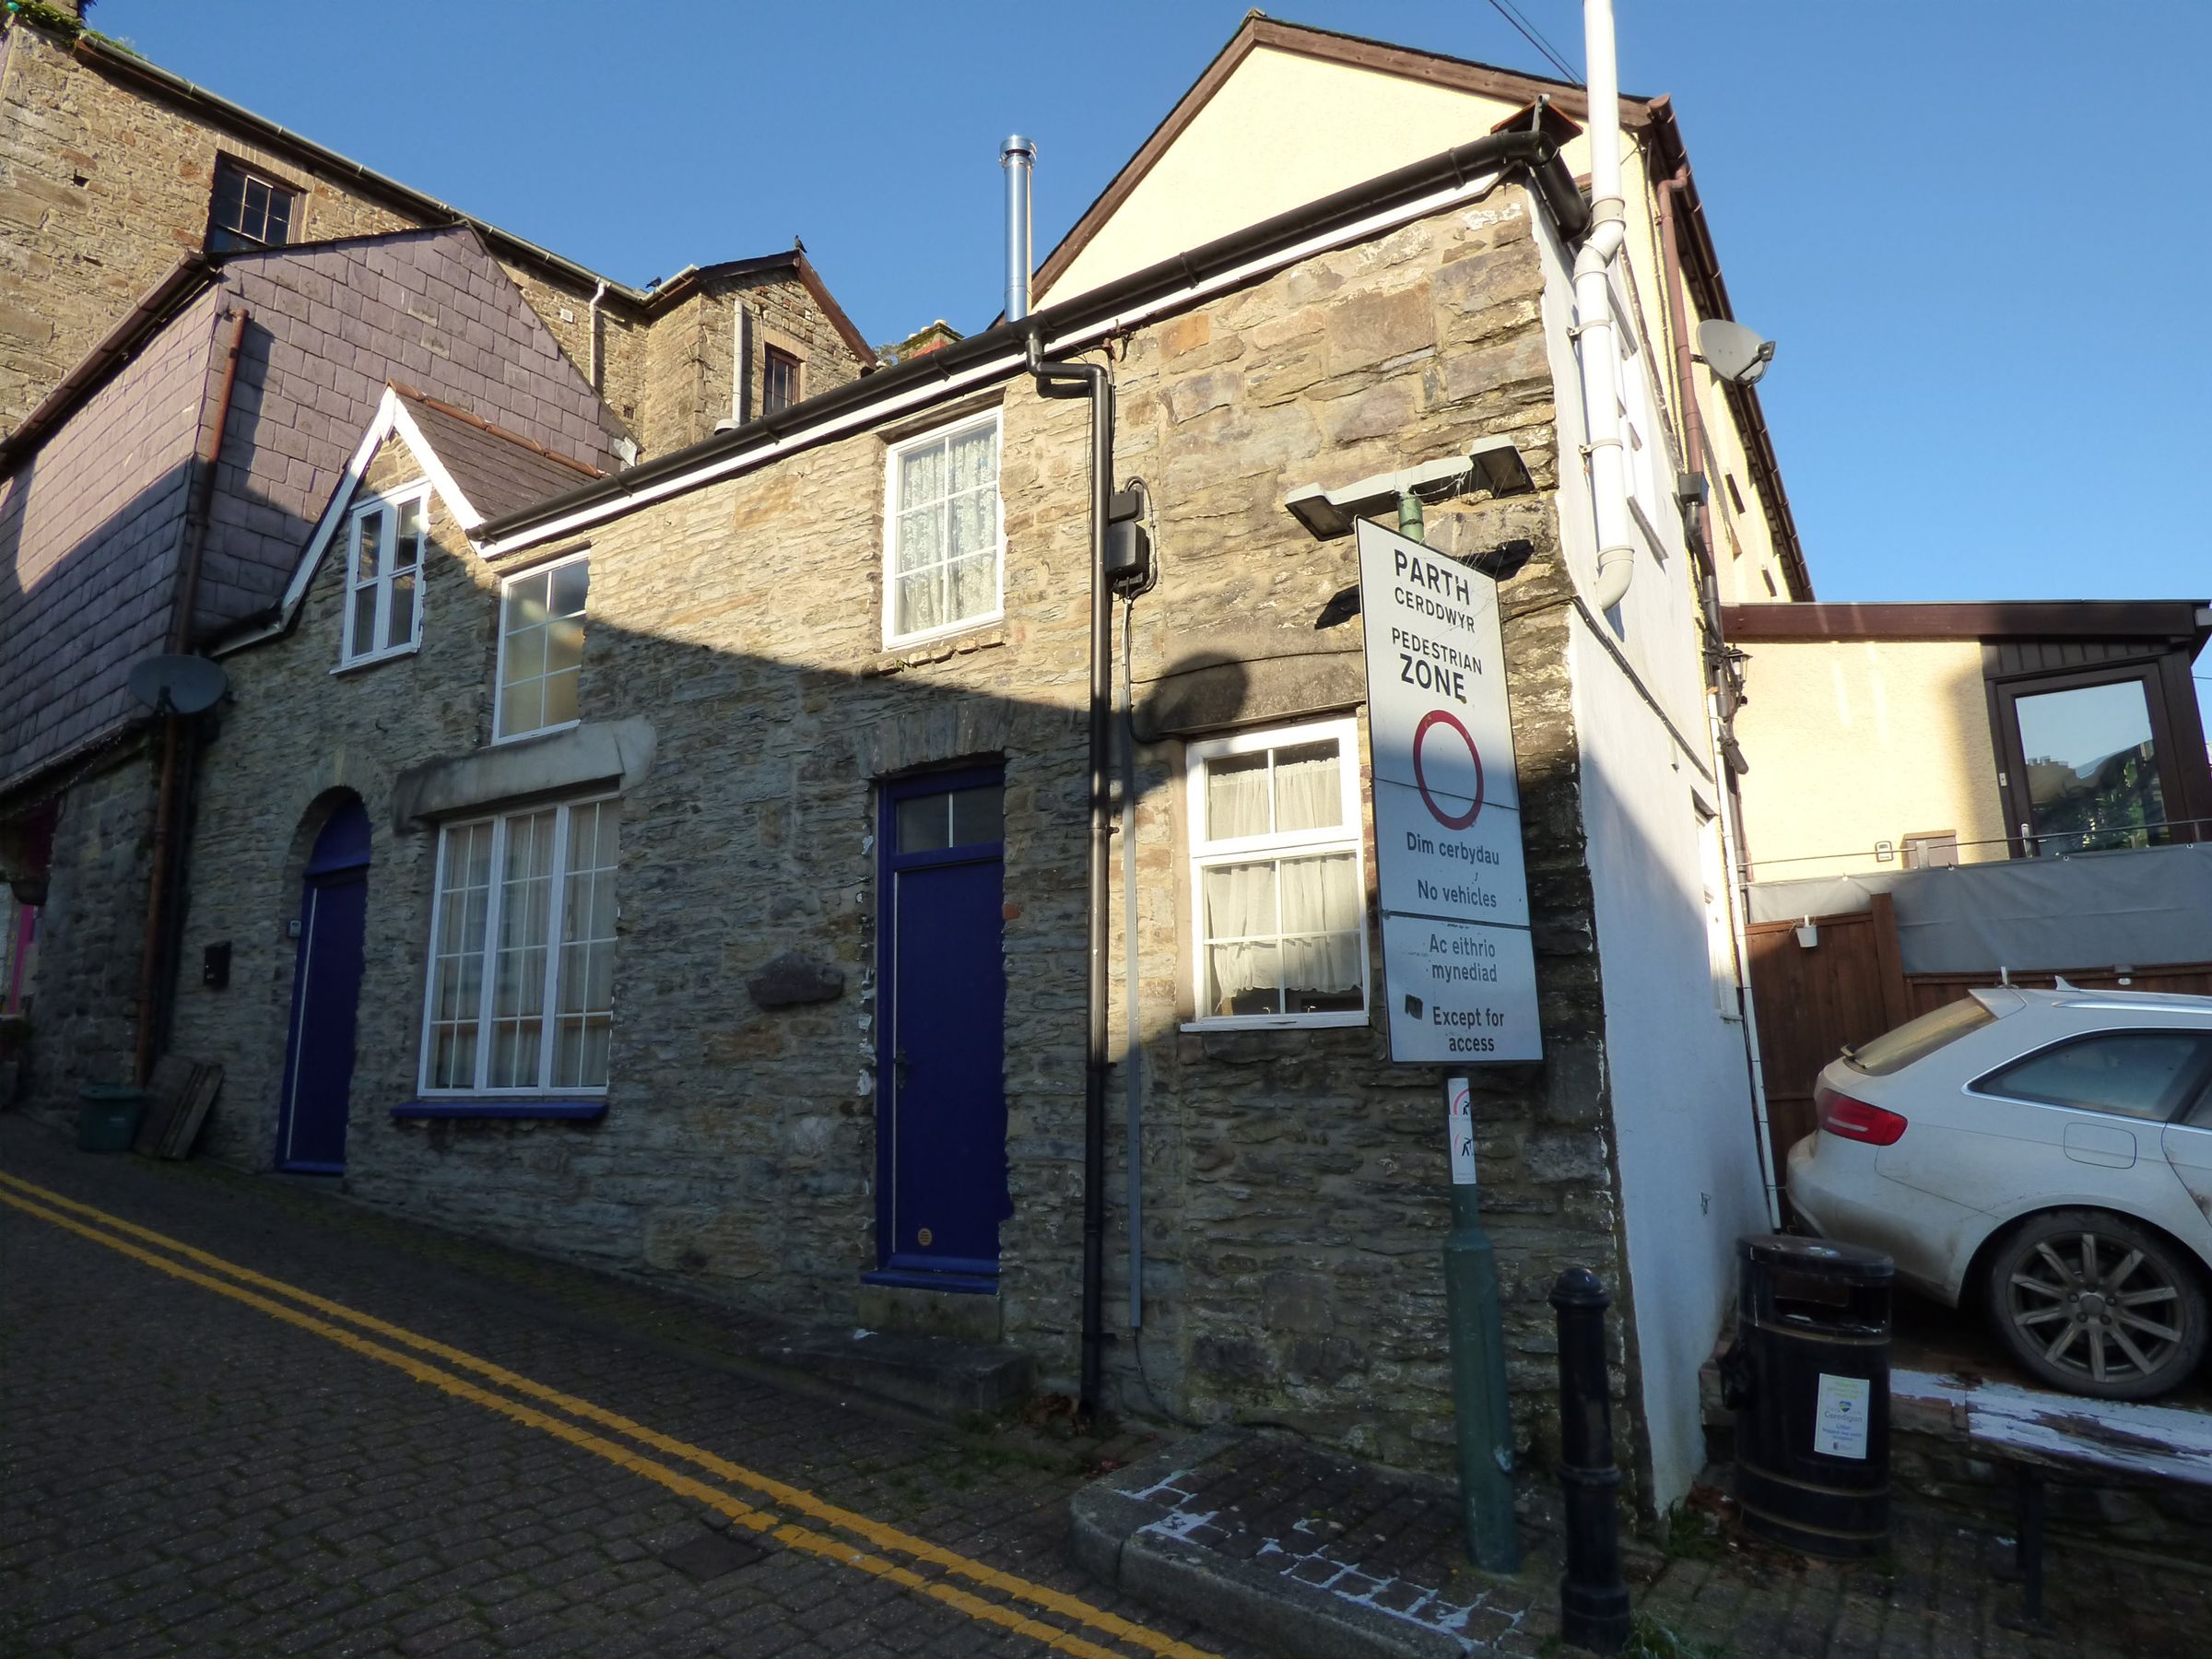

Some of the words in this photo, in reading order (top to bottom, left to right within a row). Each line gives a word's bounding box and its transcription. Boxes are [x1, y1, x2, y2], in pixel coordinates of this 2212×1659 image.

[1394, 548, 1470, 606] PARTH
[1394, 586, 1475, 633] CERDDWYR
[1392, 627, 1482, 675] PEDESTRIAN
[1399, 653, 1465, 700] ZONE
[1406, 831, 1434, 854] Dim
[1439, 841, 1500, 865] cerbydau
[1418, 878, 1438, 900] No
[1442, 885, 1497, 908] vehicles
[1430, 934, 1447, 954] Ac
[1453, 936, 1495, 958] eithrio
[1431, 963, 1498, 982] mynediad
[1432, 1006, 1481, 1030] Except
[1486, 1008, 1504, 1027] for
[1449, 1037, 1494, 1052] access
